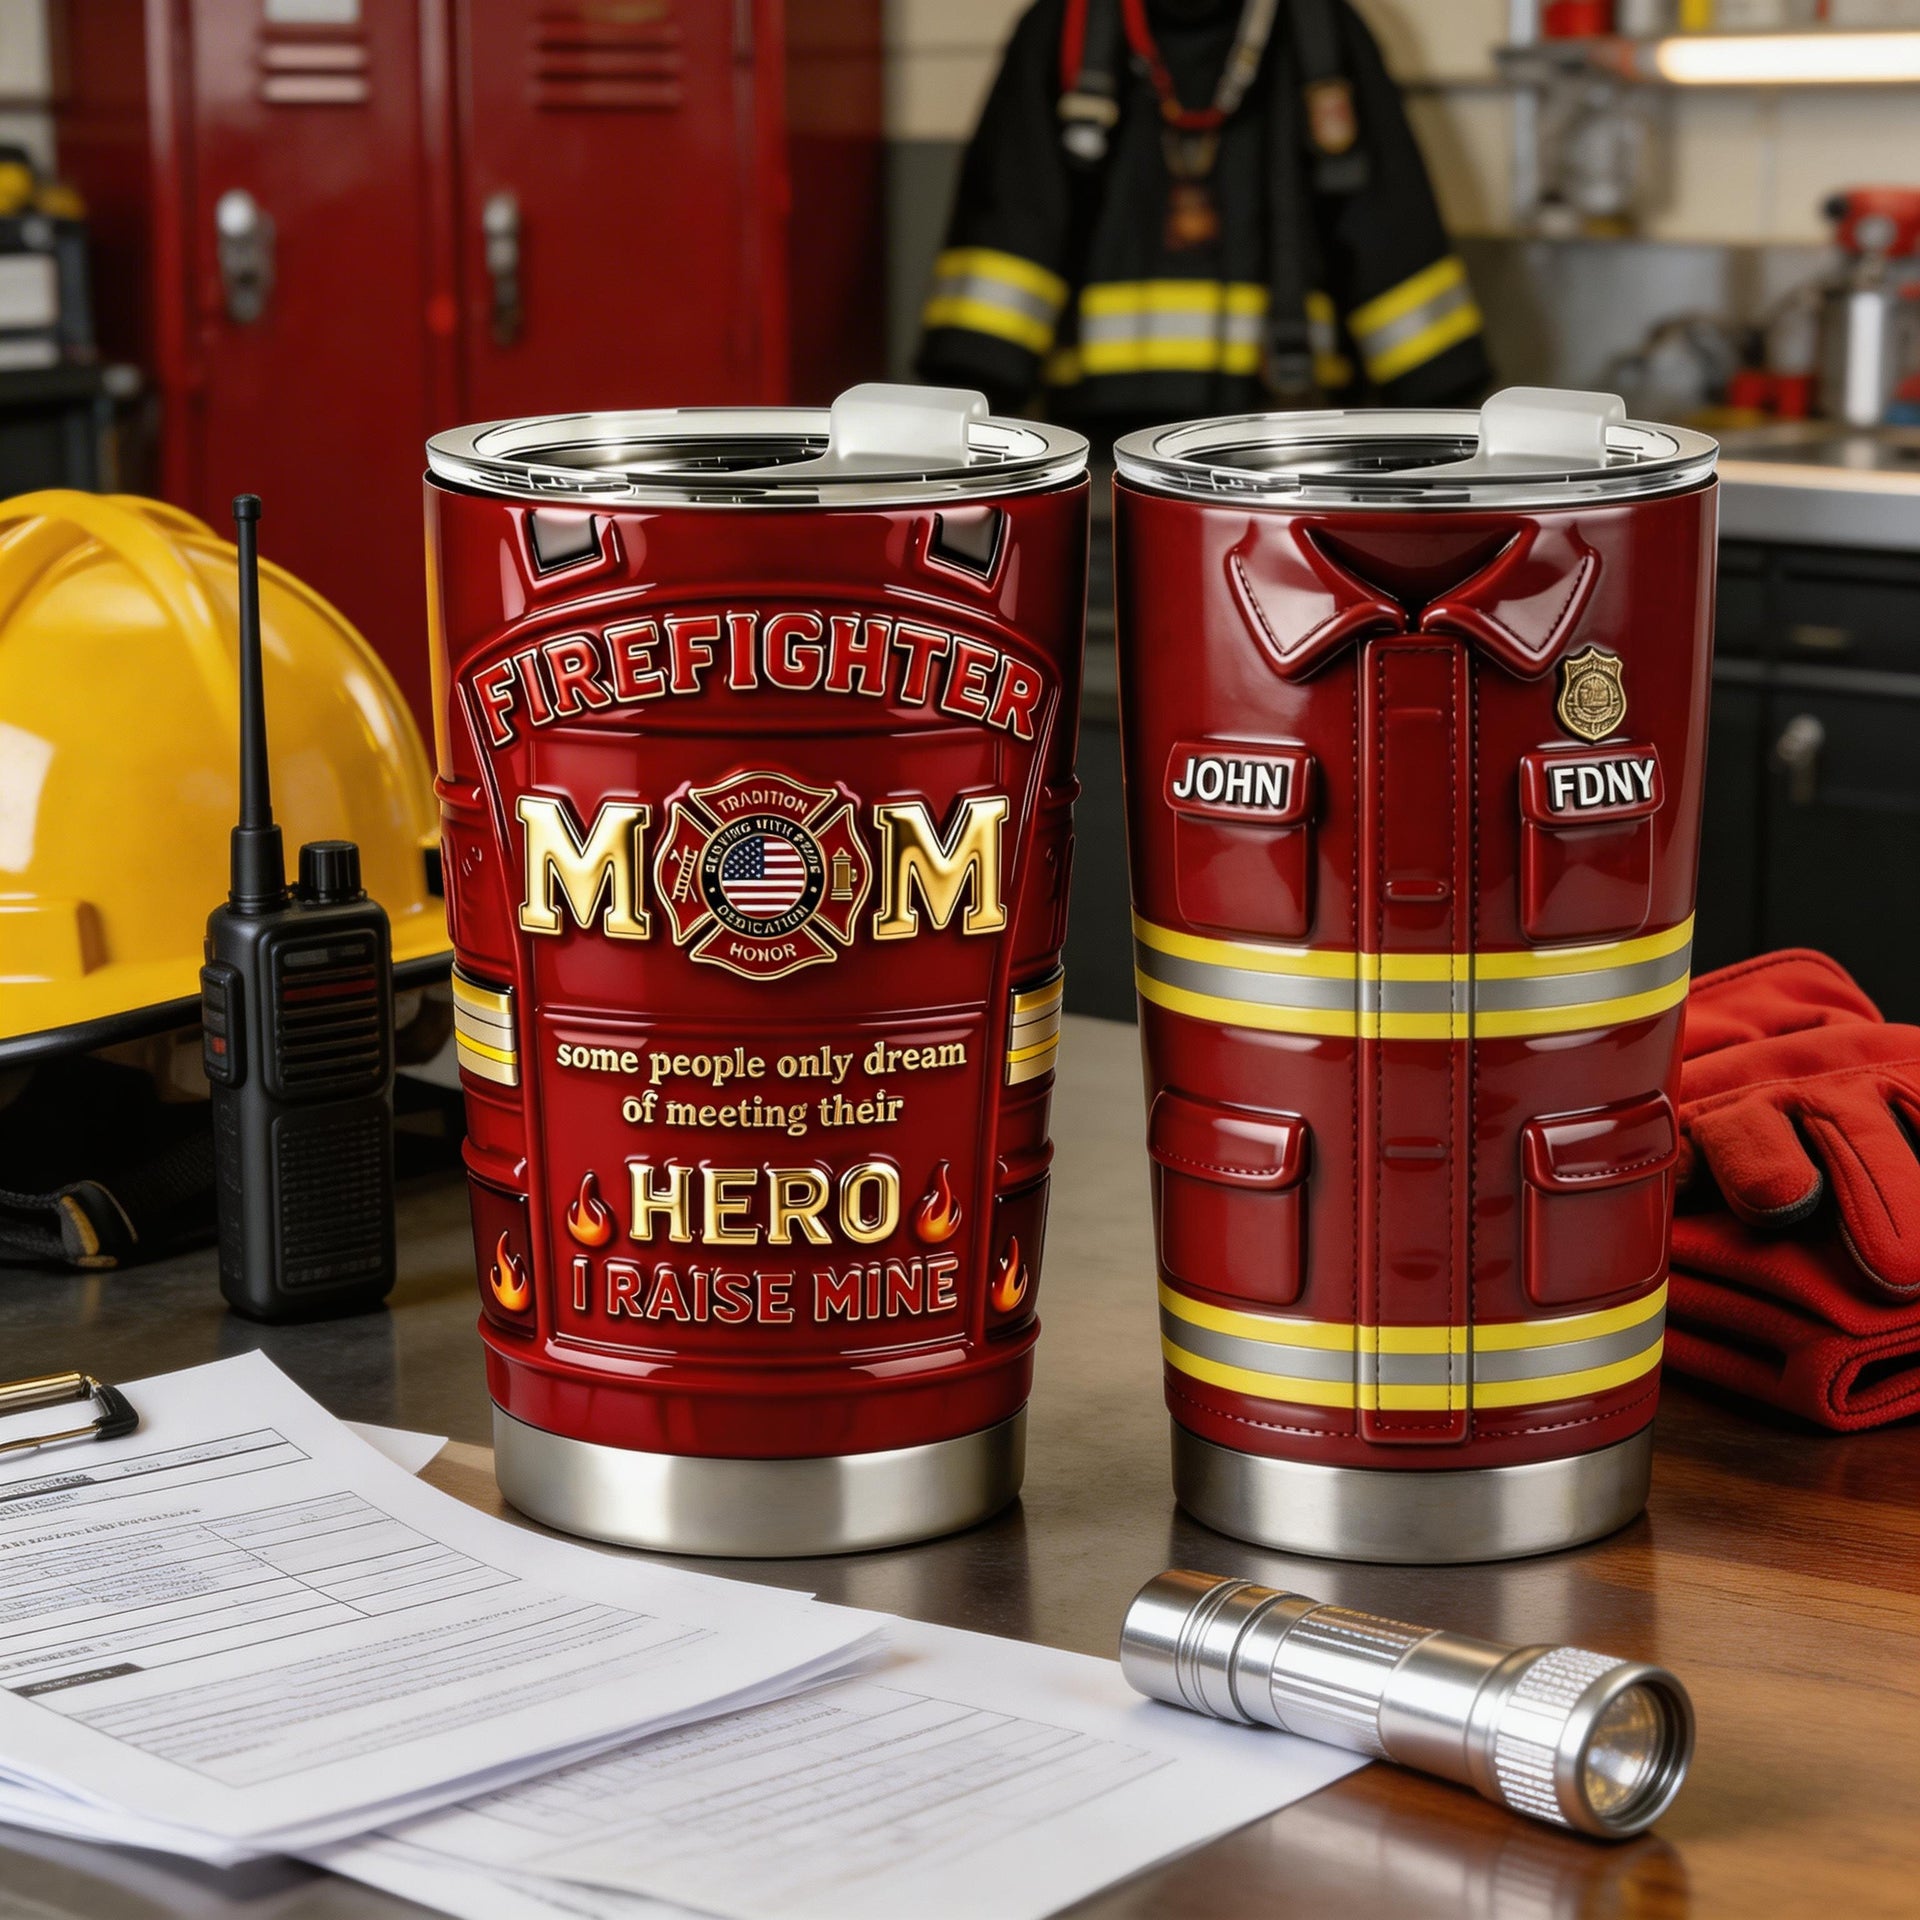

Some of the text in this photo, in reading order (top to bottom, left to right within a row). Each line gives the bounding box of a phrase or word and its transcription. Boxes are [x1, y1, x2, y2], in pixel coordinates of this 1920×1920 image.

[472, 613, 1043, 746] FIREFIGHTER
[718, 790, 808, 814] TRADITION
[1173, 757, 1284, 807] JOHN
[1553, 759, 1655, 808] FDNY
[730, 943, 796, 962] HONOR
[557, 1040, 967, 1086] some people only dream
[622, 1090, 904, 1136] of meeting their
[628, 1160, 901, 1246] HERO
[572, 1255, 959, 1324] I RAISE MINE
